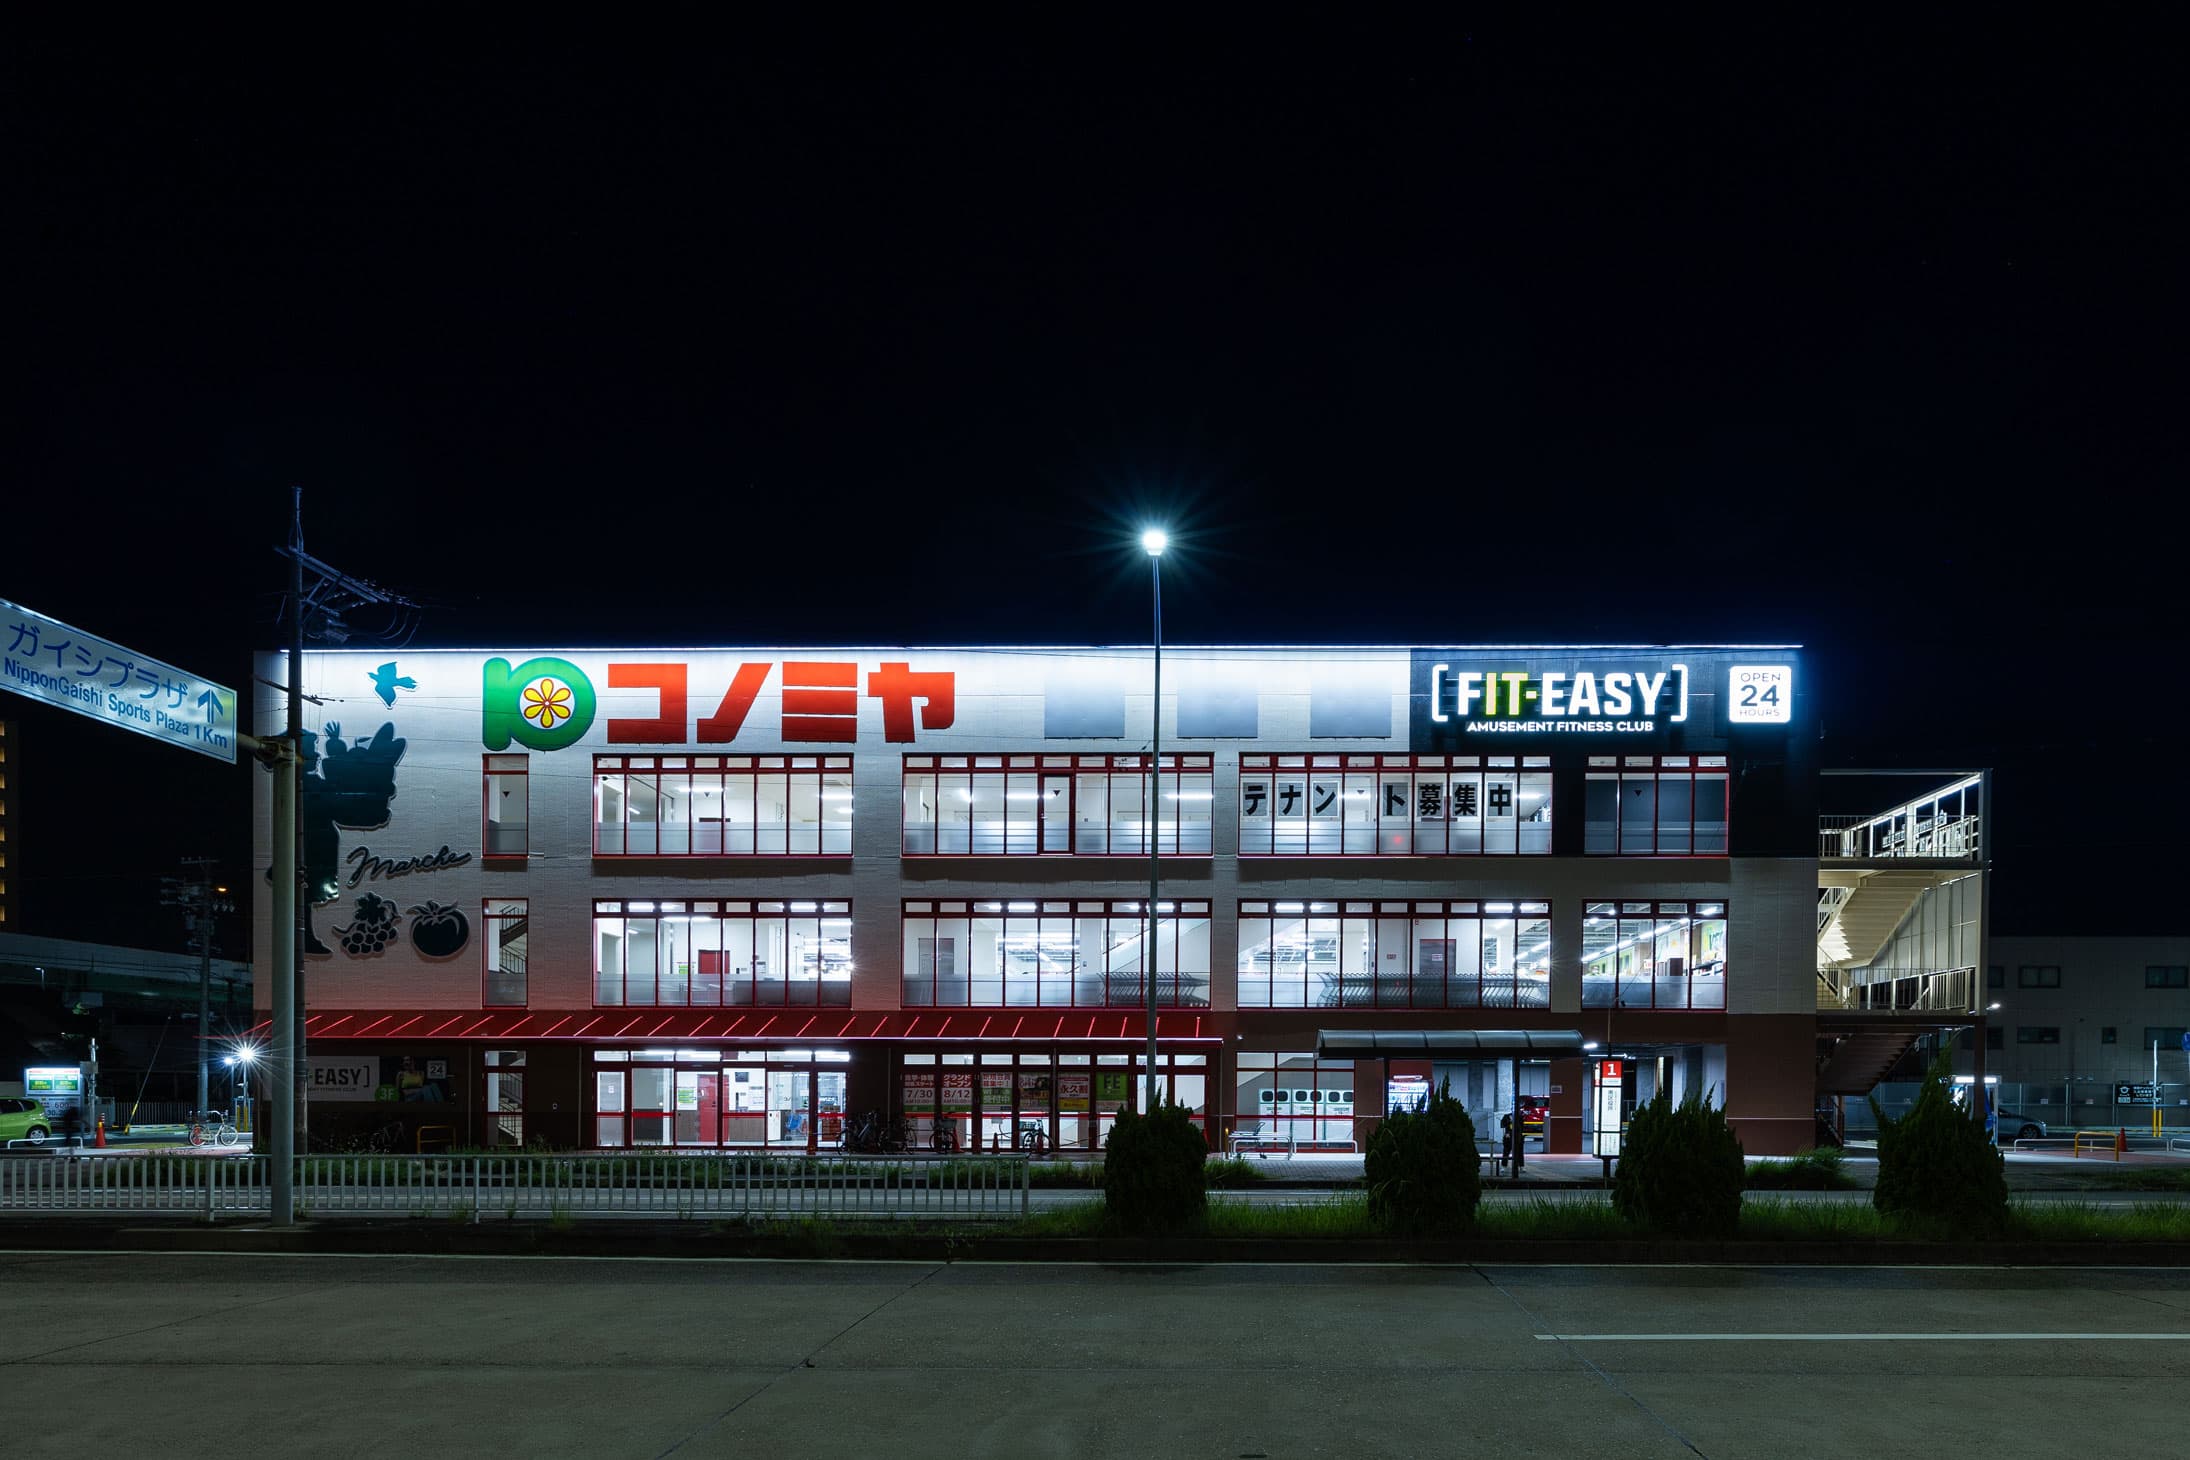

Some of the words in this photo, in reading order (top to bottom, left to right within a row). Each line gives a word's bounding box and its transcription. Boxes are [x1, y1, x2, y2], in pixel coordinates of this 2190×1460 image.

[8, 622, 189, 709] ガイシプラザ
[1740, 672, 1781, 682] OPEN
[4, 656, 104, 708] NipponGaishi
[108, 692, 151, 723] Sports
[155, 710, 190, 737] Plaza
[1740, 684, 1780, 707] 24
[607, 662, 955, 744] コノミヤ
[1739, 708, 1780, 717] HOURS
[1466, 721, 1554, 732] AMUSEMENT
[1556, 721, 1613, 732] FITNESS
[1616, 721, 1654, 732] CLUB
[346, 845, 472, 887] Marche
[1607, 1063, 1617, 1076] 1
[380, 1088, 395, 1101] 3F
[907, 1089, 933, 1098] 7/30
[943, 1089, 970, 1098] 8/12
